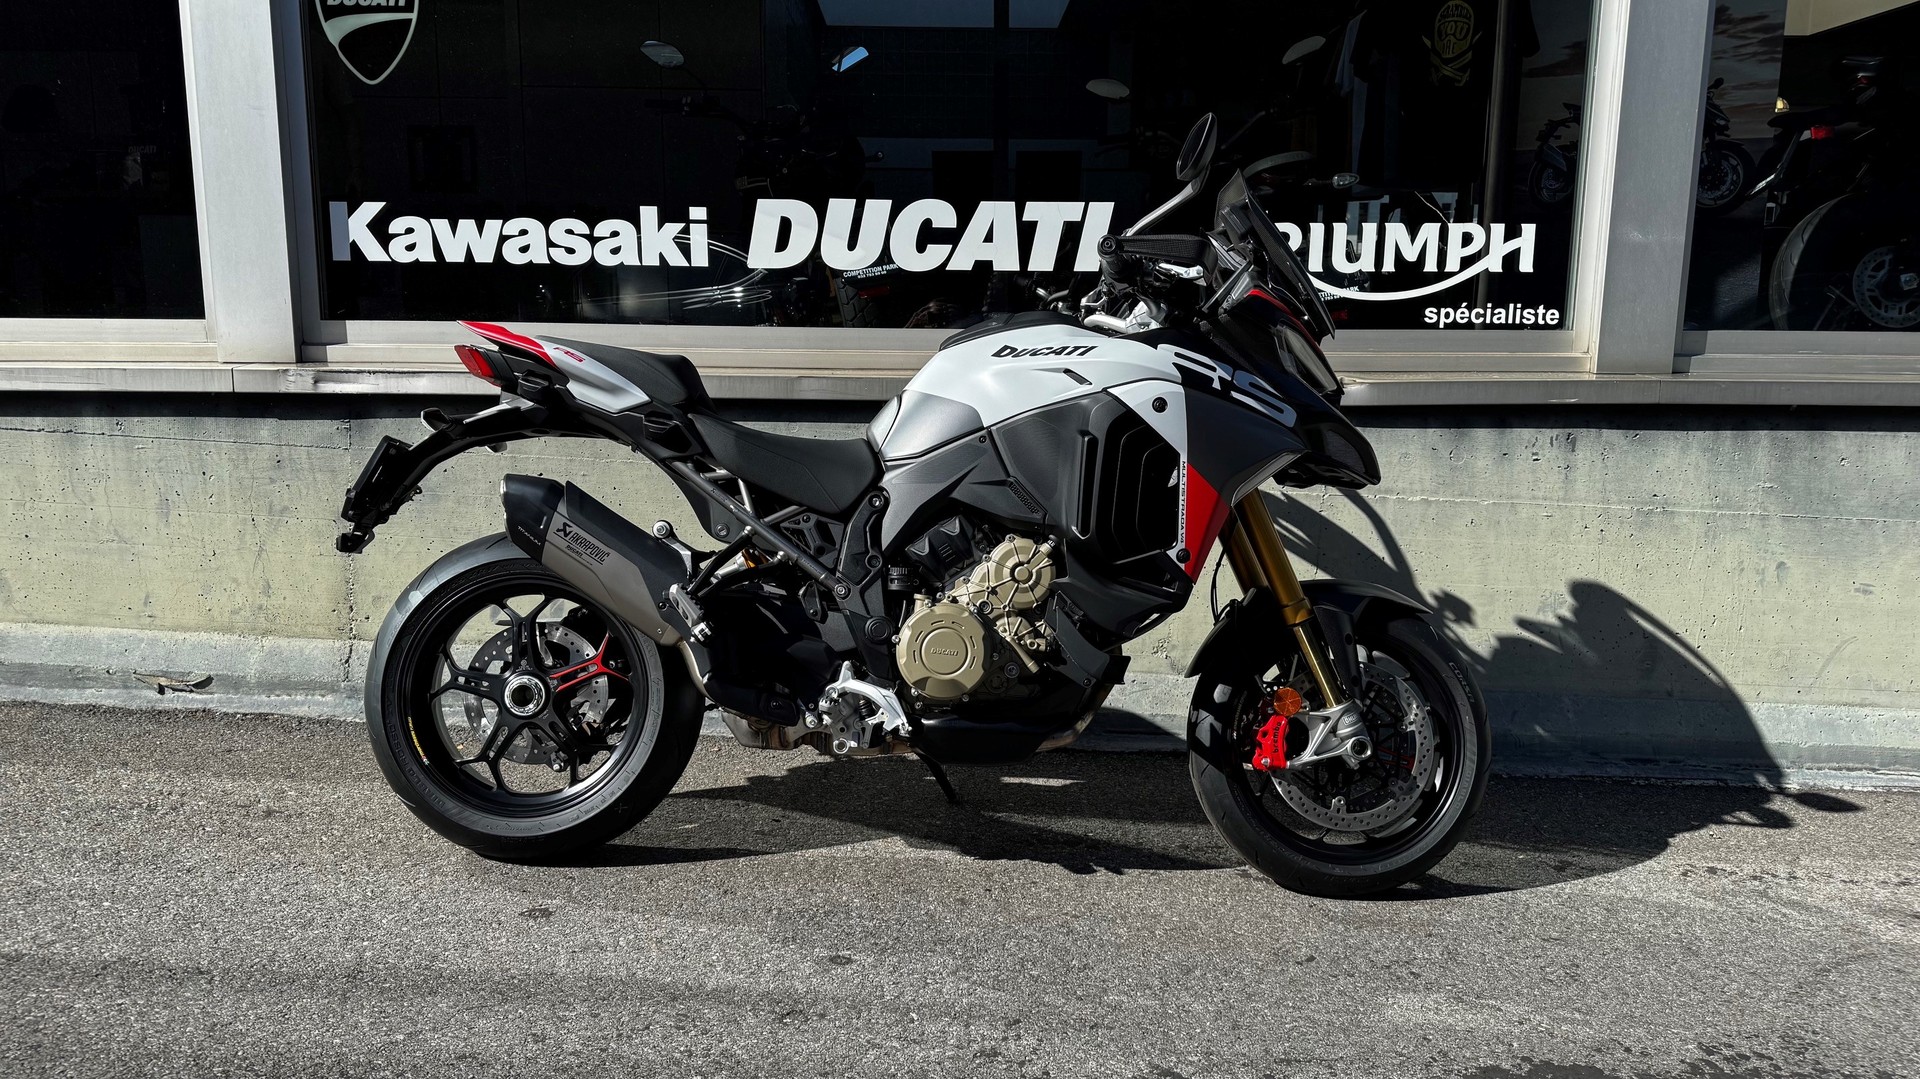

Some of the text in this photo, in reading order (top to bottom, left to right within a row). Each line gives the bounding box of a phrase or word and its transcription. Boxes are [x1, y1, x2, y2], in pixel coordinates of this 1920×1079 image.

[329, 201, 709, 267] Kawasaki
[747, 198, 1115, 272] DUCATI
[1274, 222, 1537, 273] IUMPH
[843, 265, 882, 278] COMPETITION
[883, 263, 899, 271] PARK
[1424, 303, 1560, 328] spécialiste
[991, 344, 1099, 358] DUCATI
[1163, 344, 1297, 428] RS
[930, 647, 959, 657] DUCATI
[1272, 721, 1282, 754] brembo
